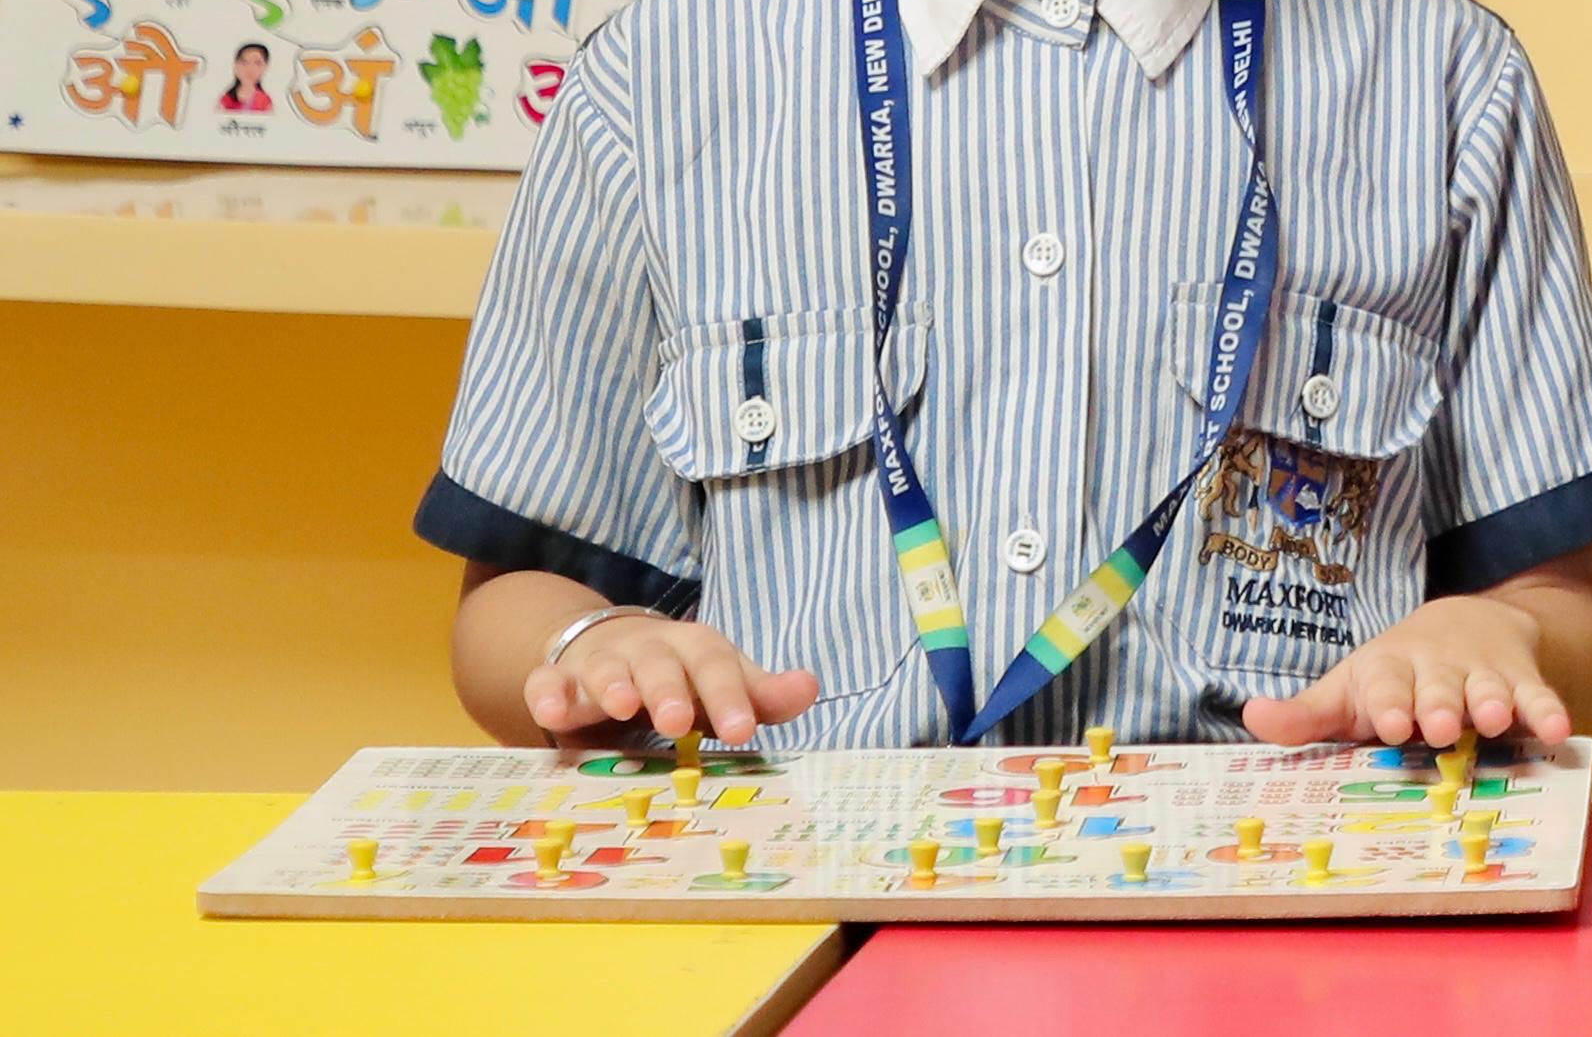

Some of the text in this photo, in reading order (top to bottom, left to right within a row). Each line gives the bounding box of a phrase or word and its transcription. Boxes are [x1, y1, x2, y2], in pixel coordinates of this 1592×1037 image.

[864, 39, 889, 94] NEW
[1231, 19, 1252, 89] DELHI
[870, 98, 896, 217] DWARKA,
[1209, 289, 1255, 413] SCHOOL,
[1223, 540, 1271, 569] BODY
[1226, 576, 1348, 619] MAXFORT
